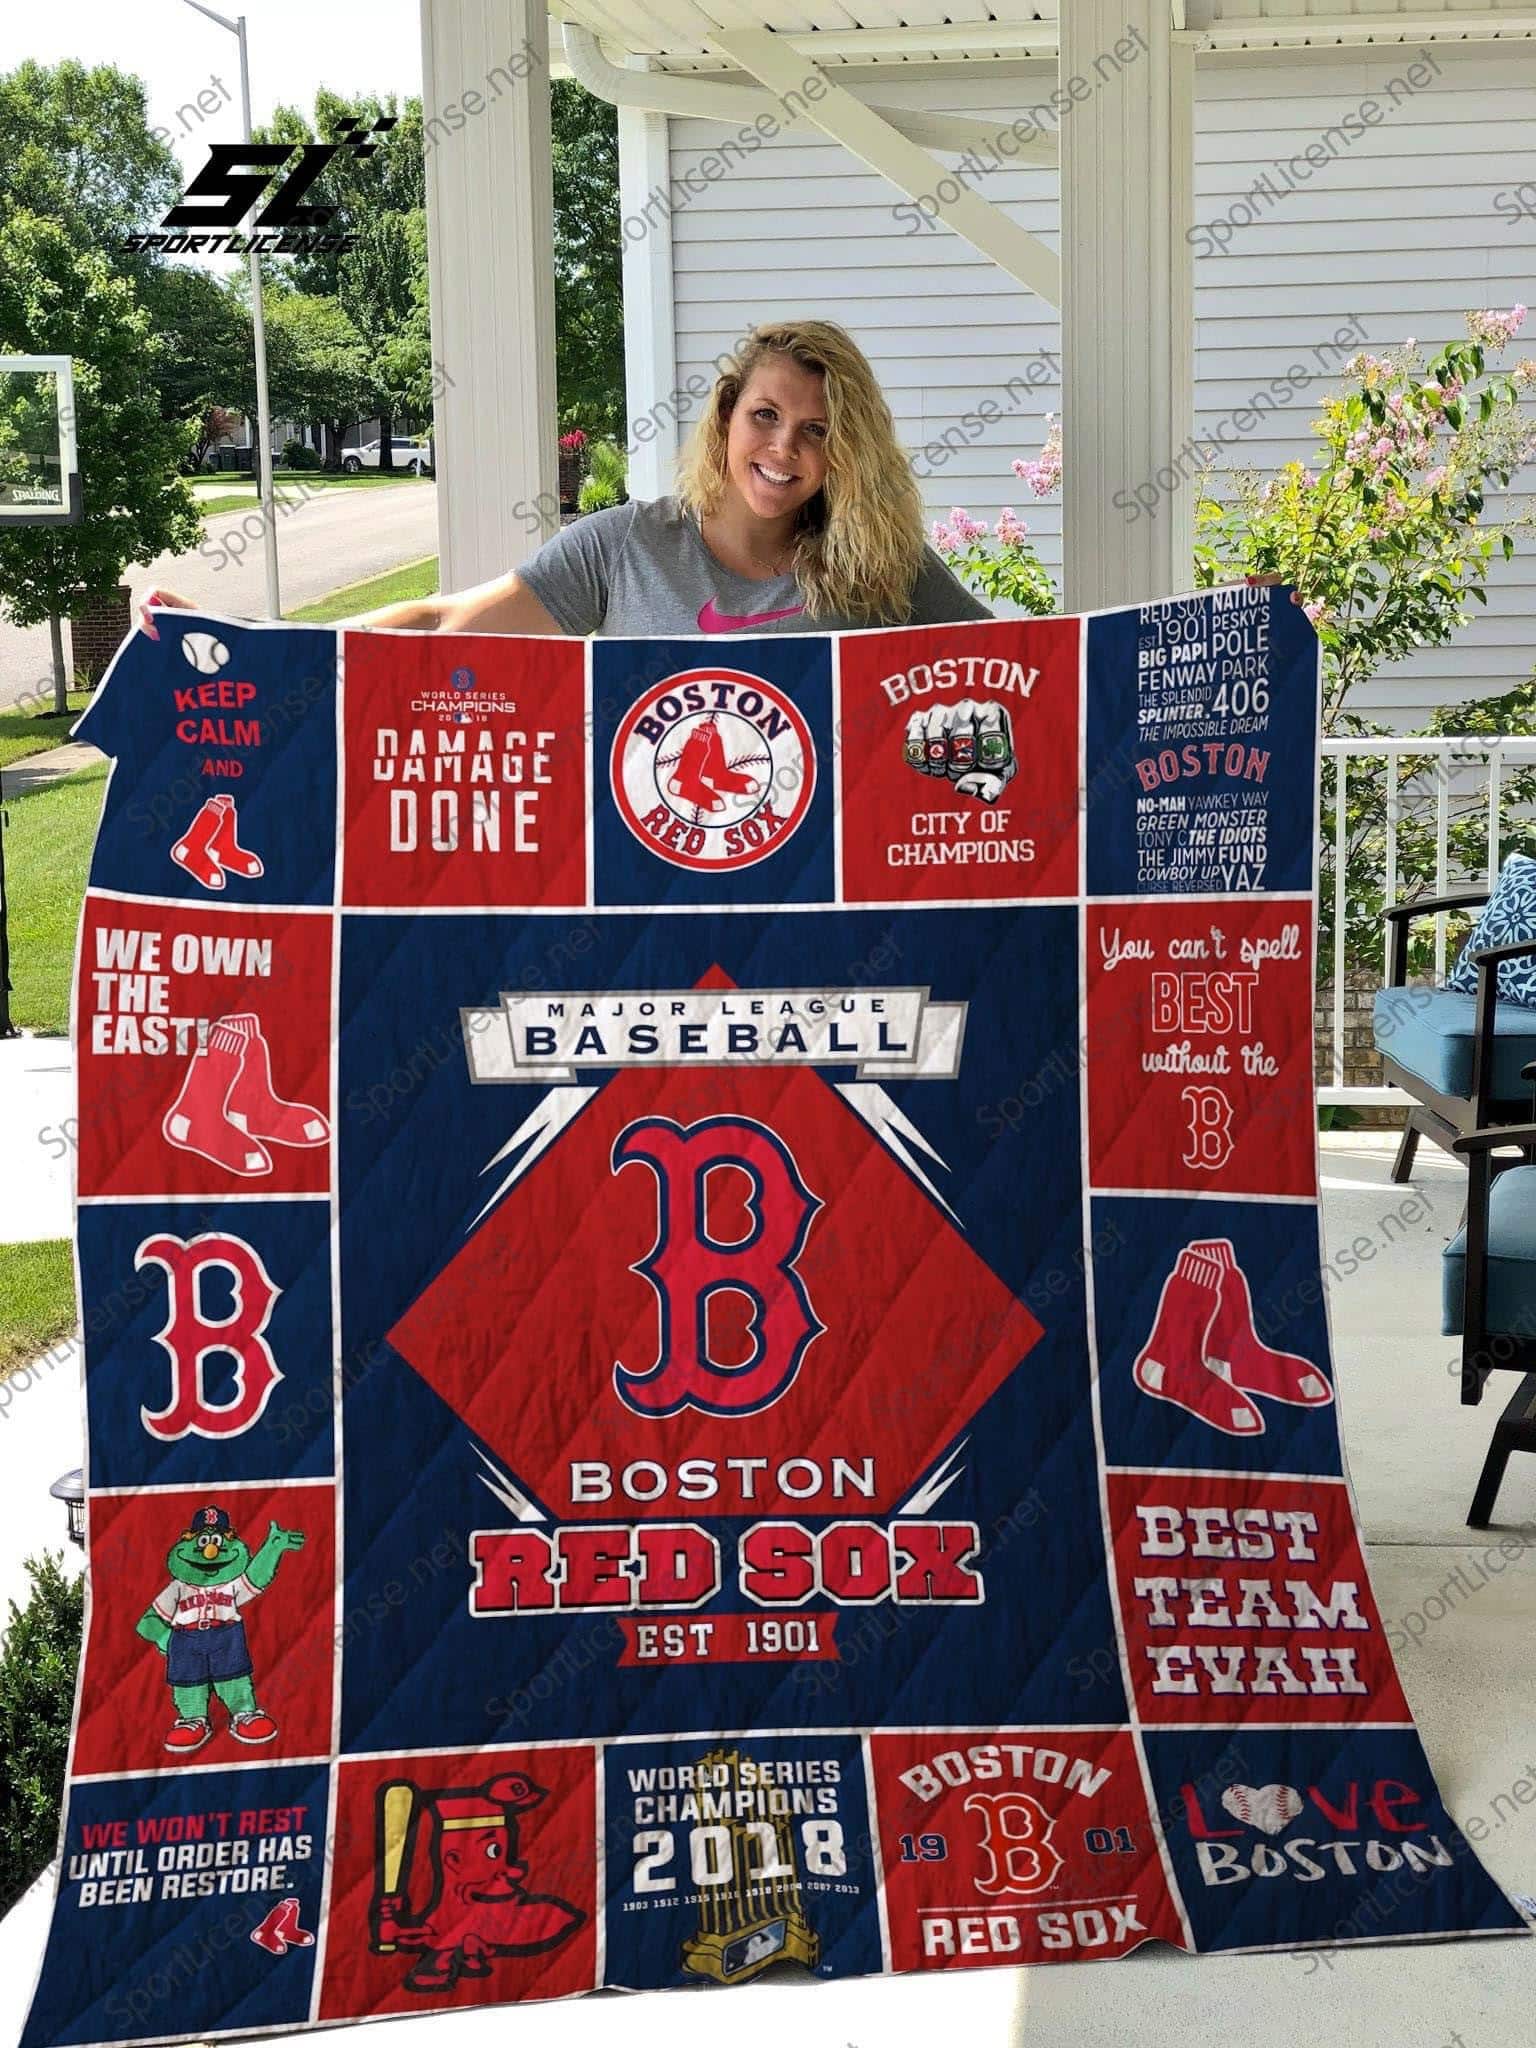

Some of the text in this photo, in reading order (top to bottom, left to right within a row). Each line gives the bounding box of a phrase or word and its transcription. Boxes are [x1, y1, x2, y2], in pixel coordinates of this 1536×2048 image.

[1140, 604, 1171, 625] RED
[1212, 586, 1271, 614] NATION
[1212, 605, 1271, 632] PESKY'S
[1138, 616, 1207, 650] EST 1901
[1212, 625, 1270, 660] POLE
[1138, 642, 1207, 670] BIG PAPI
[1138, 656, 1269, 692] FENWAY PARK
[174, 681, 258, 713] KEEP
[421, 691, 506, 701] WORLD SERIES
[880, 657, 1040, 706] BOSTON
[1138, 687, 1212, 708] THE SPLENDID
[411, 700, 516, 713] CHAMPIONS
[634, 683, 791, 745] BOSTON
[1137, 703, 1204, 725] SPLINTER
[176, 720, 261, 746] CALM
[1139, 715, 1269, 743] THE IMPOSSIBLE DREAM
[202, 758, 244, 778] AND
[374, 728, 555, 784] DAMAGE
[1135, 742, 1271, 792] BOSTON
[390, 790, 540, 854] DONE
[1136, 791, 1270, 814] NO-MAH YAWKEY WAY
[1136, 809, 1268, 832] GREEN MONSTER
[640, 805, 788, 857] RED SOX
[911, 810, 1012, 836] CITY OF
[1136, 831, 1172, 848] TONY
[1188, 829, 1215, 846] THE
[1218, 826, 1267, 845] IDIOTS
[887, 839, 1036, 867] CHAMPIONS
[1137, 844, 1267, 868] THE JIMMY FUND
[1137, 864, 1222, 882] COWBOY UP
[1221, 863, 1265, 891] YAZ
[95, 928, 273, 977] WE OWN
[1100, 924, 1302, 971] You can't spell
[92, 972, 170, 1014] THE
[547, 998, 884, 1018] MAJOR LEAGUE
[1151, 972, 1260, 1034] BEST
[91, 1015, 211, 1057] EAST!
[525, 1020, 909, 1057] BASEBALL
[1141, 1041, 1280, 1077] without the
[1182, 1085, 1235, 1170] B
[610, 1113, 827, 1419] B
[134, 1233, 285, 1442] B
[570, 1457, 876, 1504] BOSTON
[1135, 1504, 1319, 1562] BEST
[469, 1520, 986, 1618] RED SOX
[1134, 1577, 1371, 1631] TEAM
[637, 1621, 820, 1660] EST 1901
[1147, 1645, 1371, 1696] EVAH
[628, 1760, 842, 1793] WORLD SERIES
[898, 1744, 1112, 1802] BOSTON
[634, 1787, 838, 1824] CHAMPIONS
[81, 1806, 309, 1849] WE WON'T REST
[963, 1792, 1065, 1896] B
[1084, 1826, 1136, 1855] 01
[68, 1834, 313, 1881] UNTIL ORDER HAS
[632, 1819, 848, 1894] 2018
[899, 1833, 948, 1862] 19
[1194, 1835, 1453, 1887] BOSTON
[78, 1864, 295, 1908] BEEN RESTORE.
[922, 1904, 1148, 1957] RED SOX
